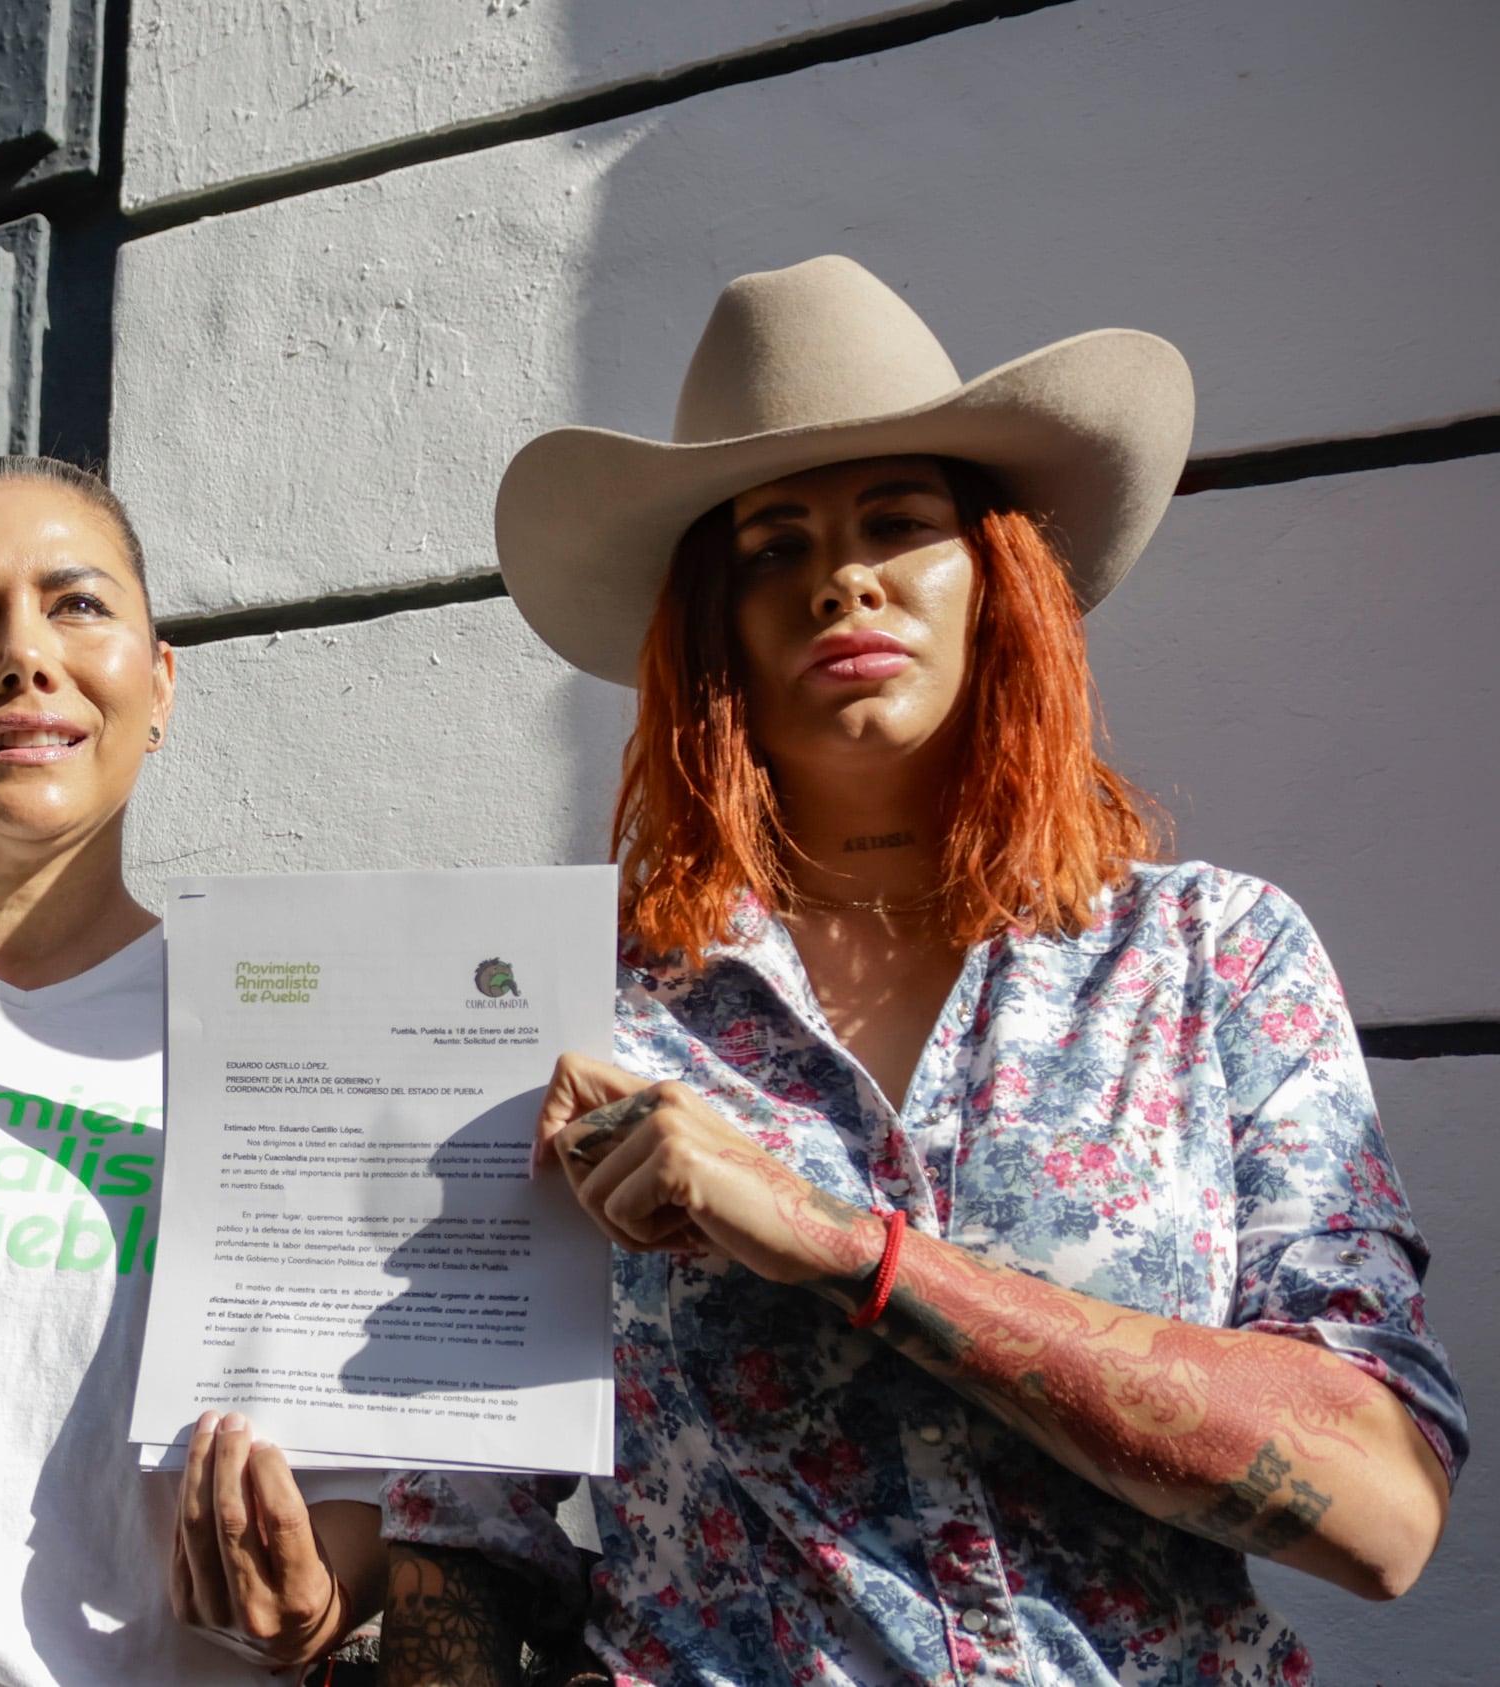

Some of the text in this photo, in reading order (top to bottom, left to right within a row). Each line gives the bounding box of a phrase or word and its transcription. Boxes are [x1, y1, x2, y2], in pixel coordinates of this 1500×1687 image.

[236, 961, 320, 974] Movimiento
[235, 975, 319, 989] Animalista
[241, 990, 310, 1003] de Puebla
[465, 999, 529, 1009] CUACOLANDIA
[420, 1026, 445, 1034] Puebla
[456, 1026, 465, 1034] 18
[467, 1026, 477, 1034] de
[479, 1026, 500, 1034] Enero
[503, 1026, 515, 1034] del
[518, 1026, 539, 1034] 2024
[433, 1036, 538, 1044] Asunto: Solicitud de reunión
[297, 1076, 319, 1084] JUNTA
[225, 1084, 282, 1093] COORDINACIÓN
[284, 1084, 317, 1093] POLÍTICA
[346, 1086, 388, 1094] CONGRESO
[440, 1087, 450, 1095] DE
[223, 1123, 256, 1131] Estimado
[279, 1124, 309, 1132] Eduardo
[311, 1125, 337, 1133] Castillo
